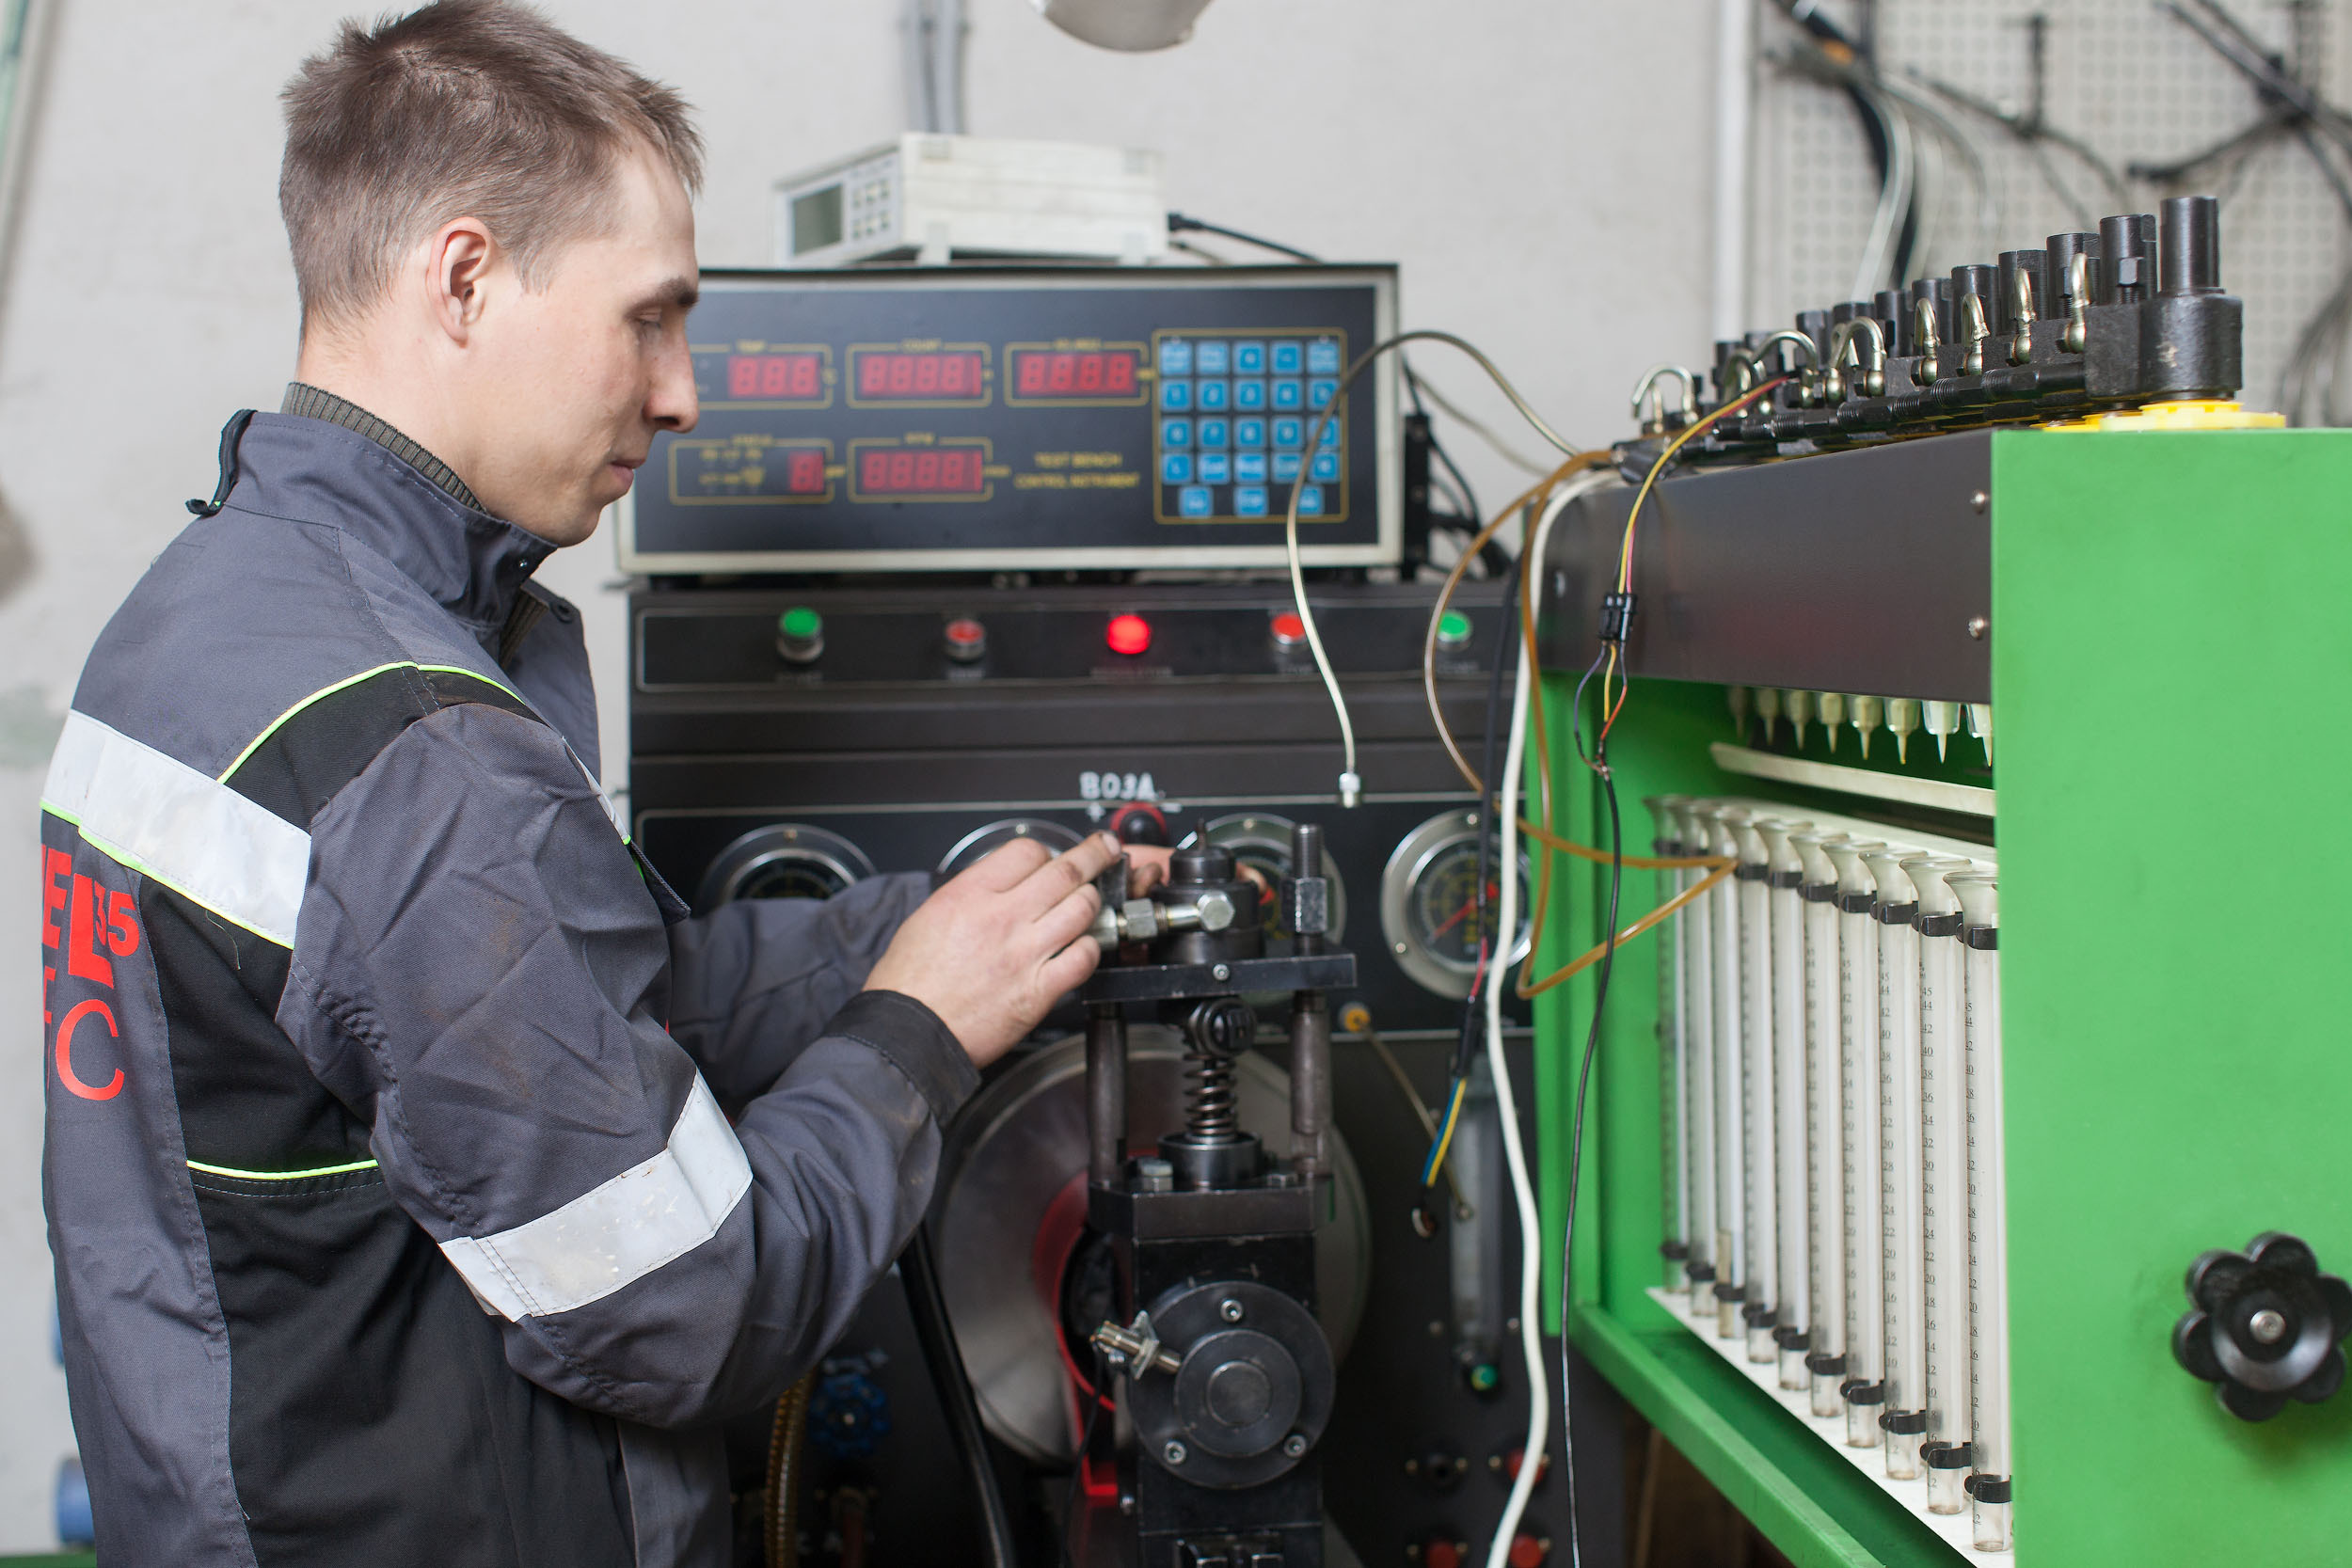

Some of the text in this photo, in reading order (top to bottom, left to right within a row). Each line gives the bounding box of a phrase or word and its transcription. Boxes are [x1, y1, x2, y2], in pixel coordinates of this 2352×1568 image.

[1921, 987, 1932, 997] 45
[1922, 1000, 1932, 1010] 44
[1921, 1023, 1932, 1034] 42
[1922, 1046, 1933, 1056] 40
[1922, 1069, 1933, 1080] 38
[1923, 1092, 1933, 1102] 36
[1924, 1115, 1933, 1125] 34
[1924, 1137, 1933, 1148] 32
[1924, 1161, 1934, 1171] 30
[1924, 1184, 1934, 1195] 28
[1924, 1207, 1934, 1217] 26
[1924, 1229, 1934, 1240] 24
[1925, 1251, 1934, 1262] 22
[1925, 1274, 1935, 1284] 20
[1926, 1297, 1935, 1307] 18
[1926, 1320, 1936, 1330] 16
[1927, 1342, 1935, 1353] 14
[1927, 1365, 1936, 1375] 12
[1927, 1388, 1937, 1399] 10
